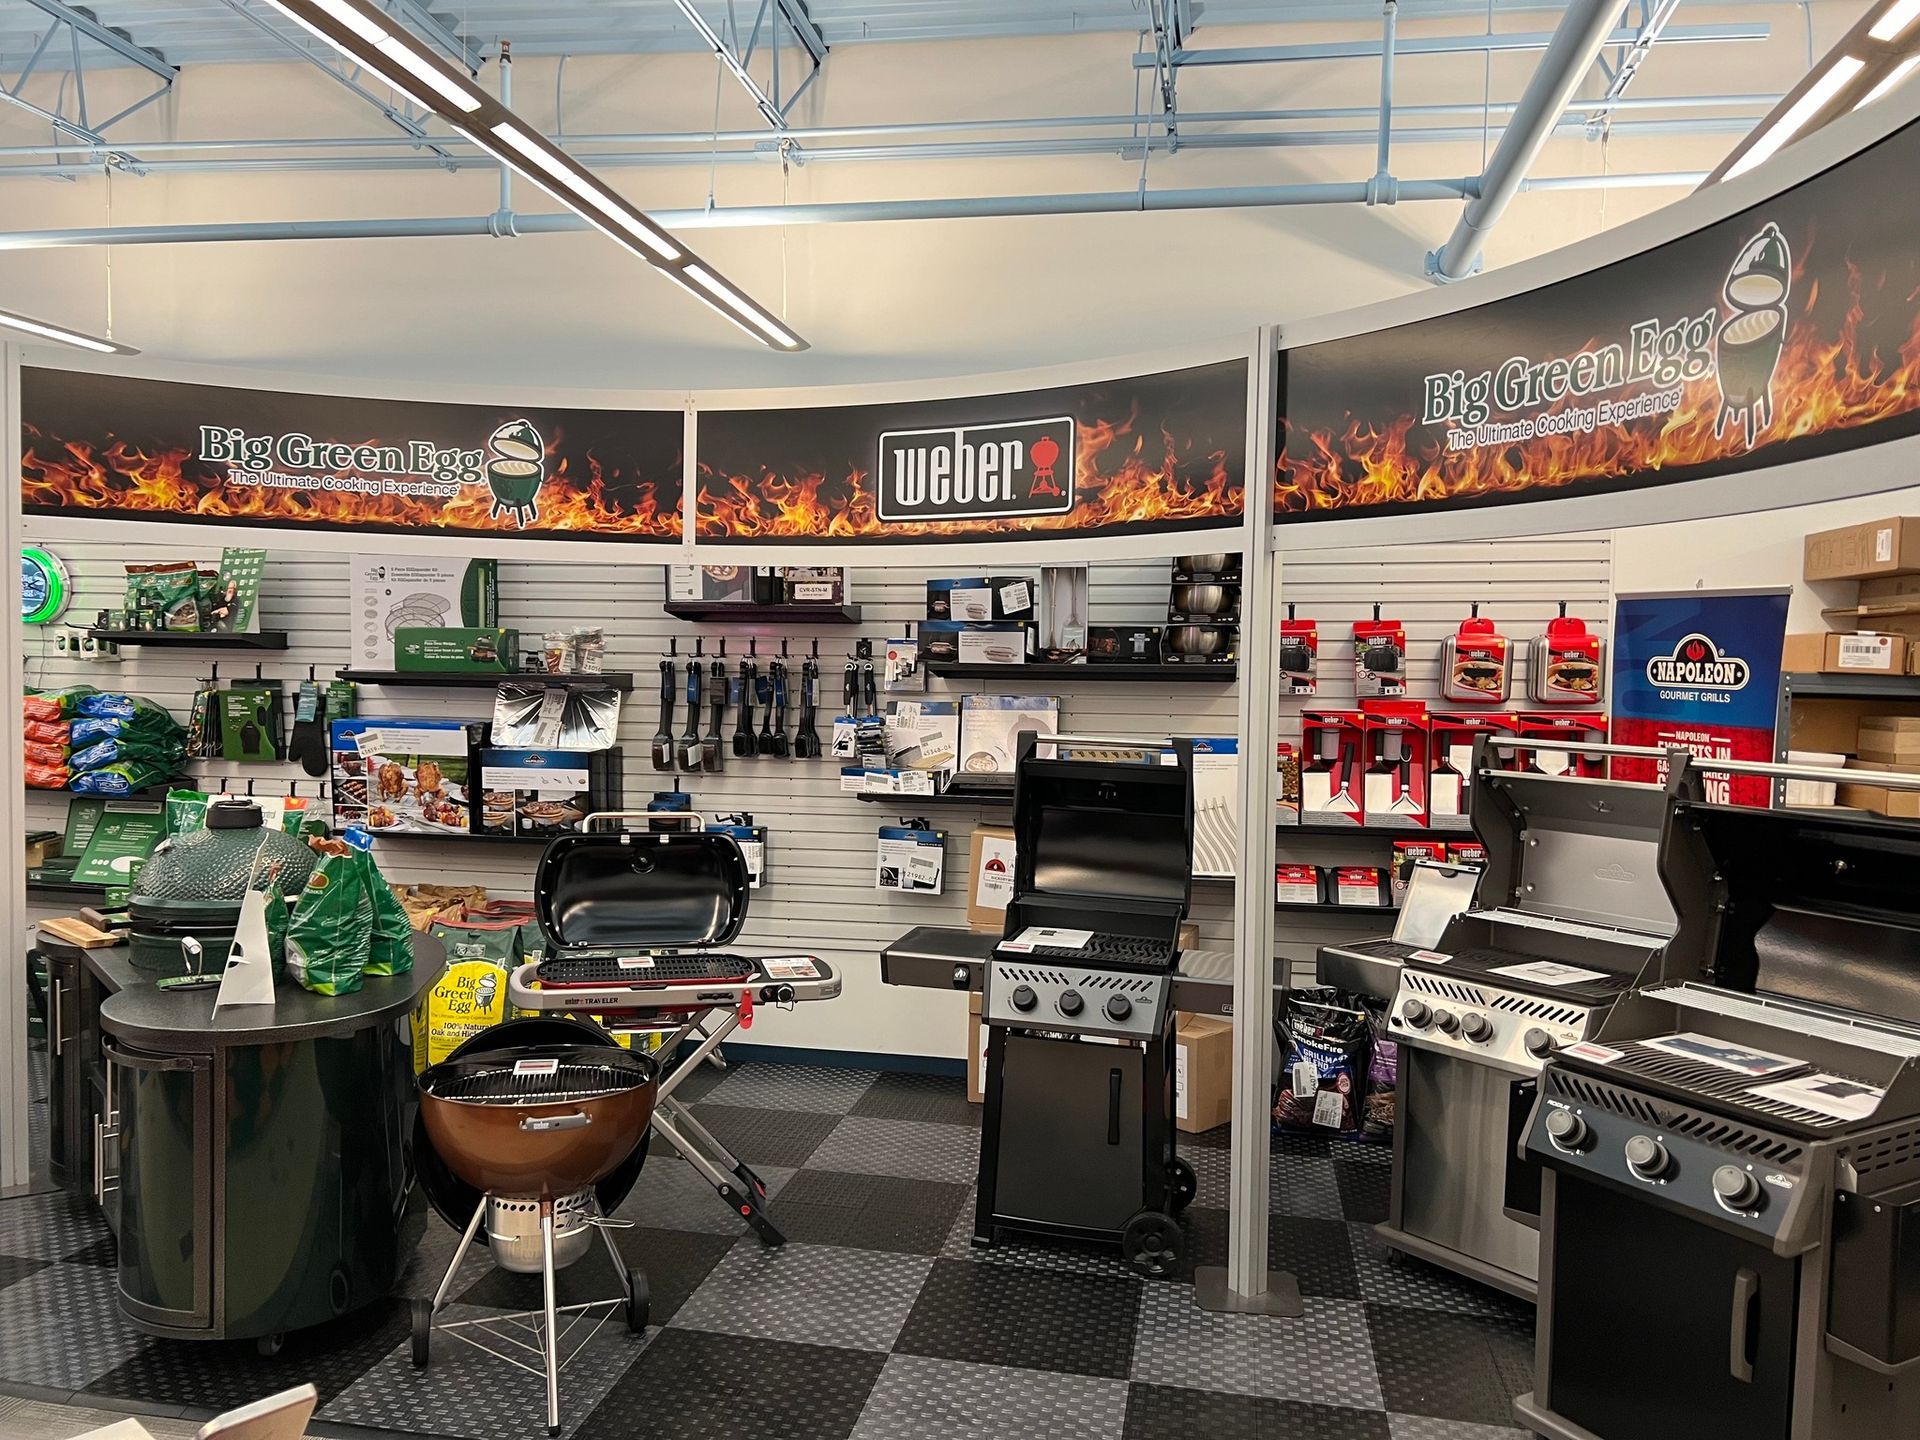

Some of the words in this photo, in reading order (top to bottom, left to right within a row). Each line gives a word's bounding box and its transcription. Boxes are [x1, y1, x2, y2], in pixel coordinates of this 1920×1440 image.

[1422, 370, 1492, 428] Big
[1495, 343, 1627, 411] Green
[1626, 308, 1717, 388] Egg
[1447, 427, 1475, 450] The
[1476, 420, 1534, 446] Ultimate
[1536, 408, 1595, 436] Cooking
[1598, 391, 1681, 424] Experience
[199, 425, 273, 472] Big
[276, 433, 405, 474] Green
[407, 441, 484, 483] Egg
[893, 430, 1023, 506] weber
[228, 470, 258, 486] The
[261, 472, 320, 490] Ultimate
[323, 477, 380, 496] Cooking
[383, 480, 458, 498] Experience
[1281, 637, 1300, 645] weber
[1368, 637, 1388, 645] weber
[1470, 650, 1486, 658] weber
[1564, 651, 1580, 659] weber
[1657, 661, 1735, 684] NAPOLEON
[1660, 690, 1699, 701] GOURMET
[1700, 692, 1731, 703] GRILLS
[1324, 716, 1340, 724] weber
[1675, 731, 1710, 743] NAPOLEON
[1407, 848, 1427, 857] weber
[1461, 849, 1481, 858] weber
[457, 976, 477, 990] Big
[434, 986, 474, 1000] Green
[448, 999, 471, 1014] Egg
[431, 1028, 445, 1036] Oak
[446, 1029, 460, 1037] and
[1293, 1020, 1316, 1037] weber
[1291, 1030, 1344, 1054] SmokeFire
